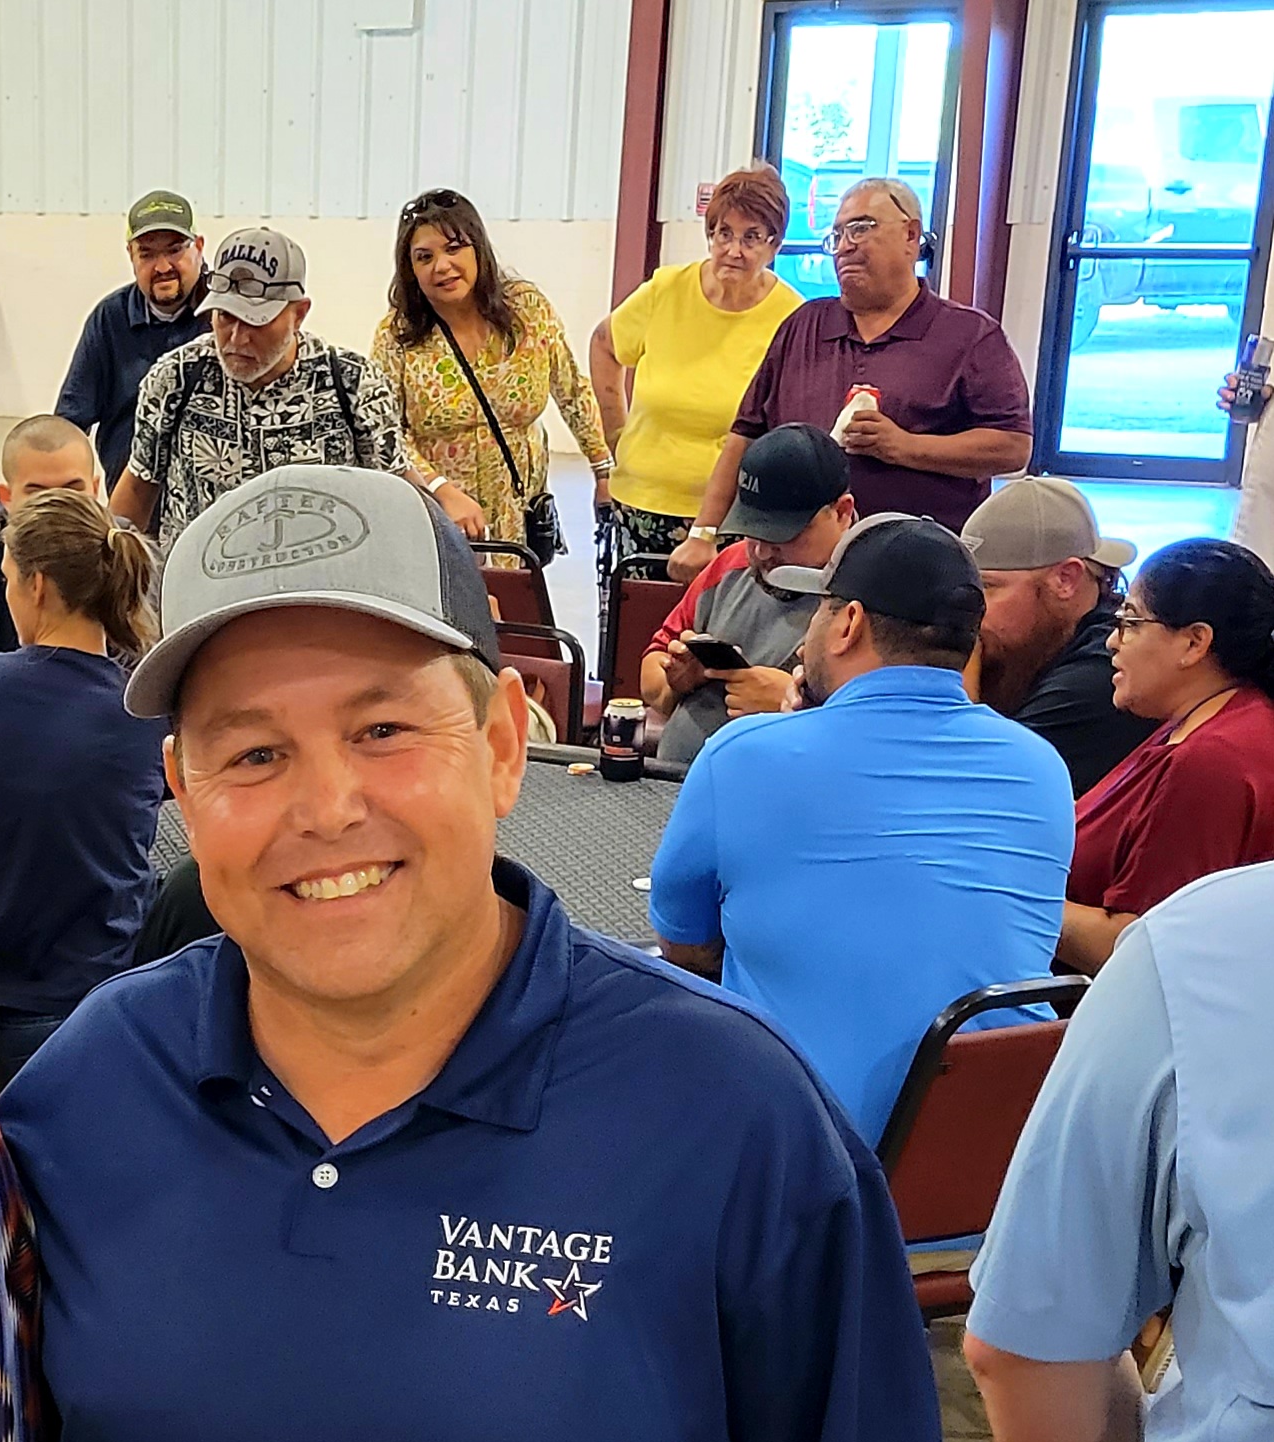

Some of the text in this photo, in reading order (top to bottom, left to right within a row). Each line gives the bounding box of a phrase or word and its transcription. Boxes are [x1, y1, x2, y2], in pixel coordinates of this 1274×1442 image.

[218, 244, 279, 279] DALLAS
[215, 494, 338, 541] RAFTER
[209, 534, 352, 574] CONSTRUCTION
[440, 1214, 614, 1264] VANTAGE
[432, 1249, 540, 1292] BANK
[430, 1290, 521, 1313] TEXAS
